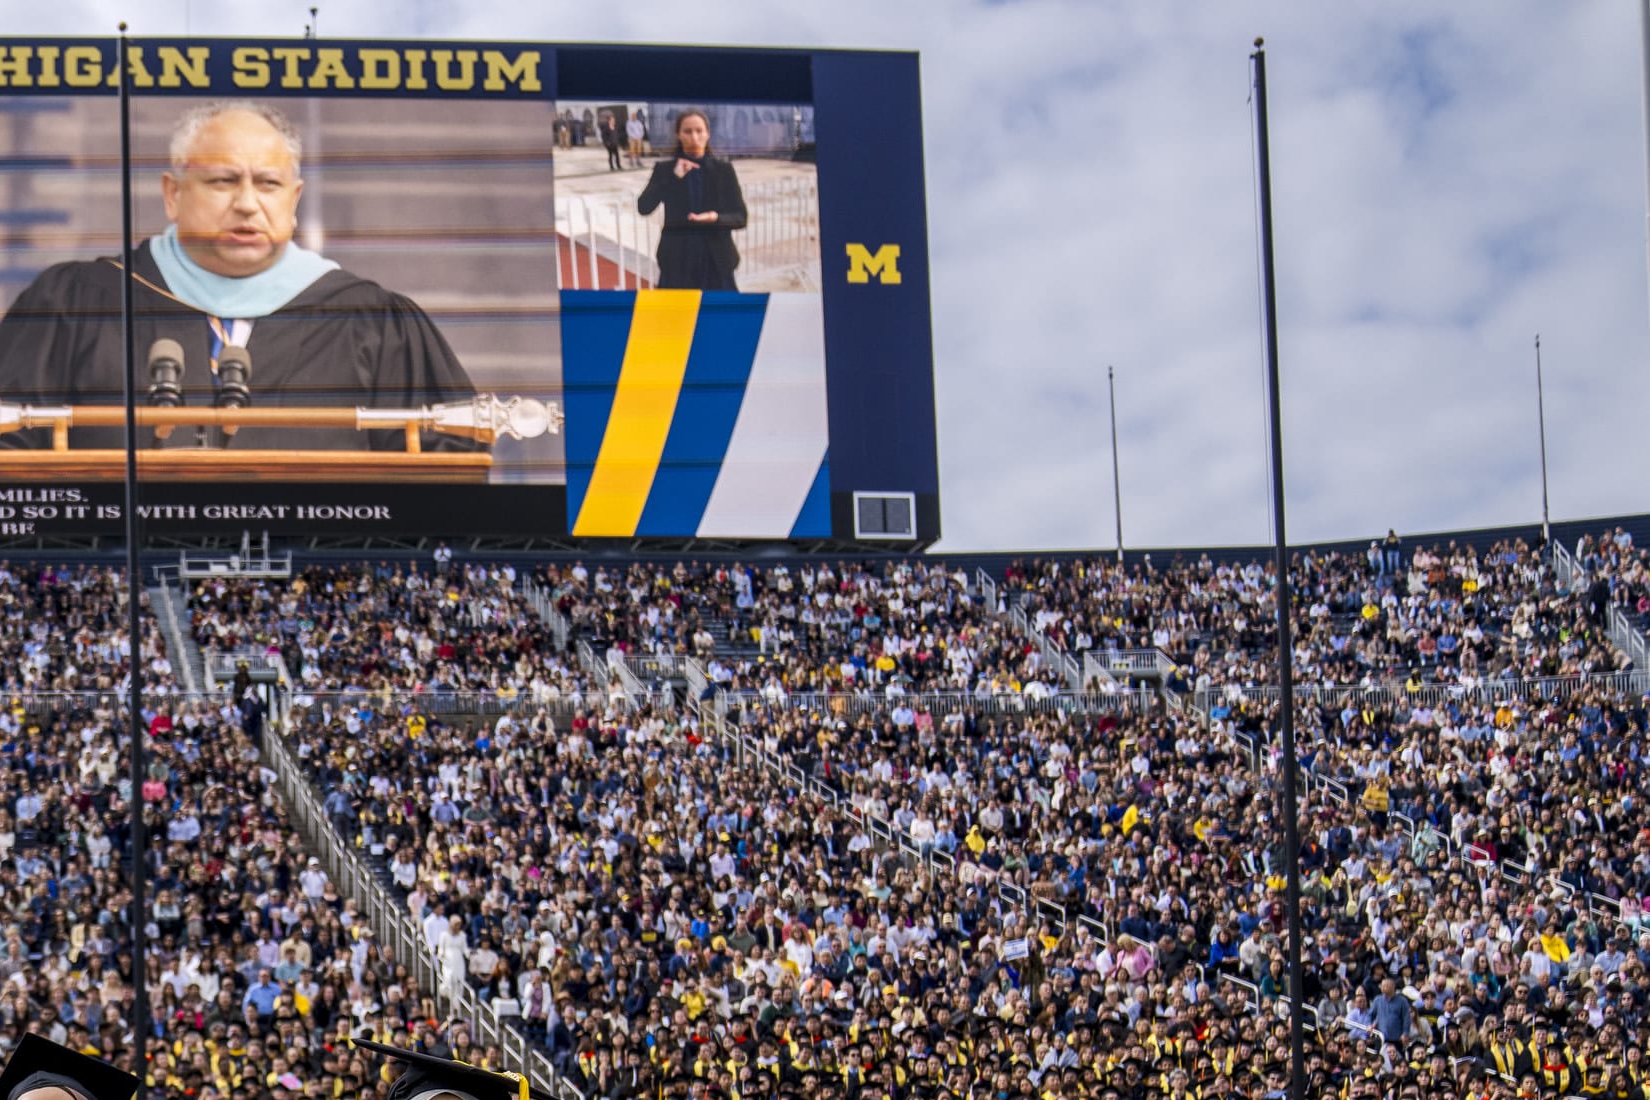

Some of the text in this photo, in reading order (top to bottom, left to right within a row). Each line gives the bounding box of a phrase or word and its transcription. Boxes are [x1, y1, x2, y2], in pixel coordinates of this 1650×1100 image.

[232, 47, 542, 91] STADIUM
[845, 243, 902, 285] M
[22, 505, 57, 519] SO
[65, 505, 90, 519] IT
[97, 505, 121, 519] IS
[202, 504, 290, 519] GREAT
[296, 504, 392, 519] HONOR
[1, 522, 35, 535] BE
